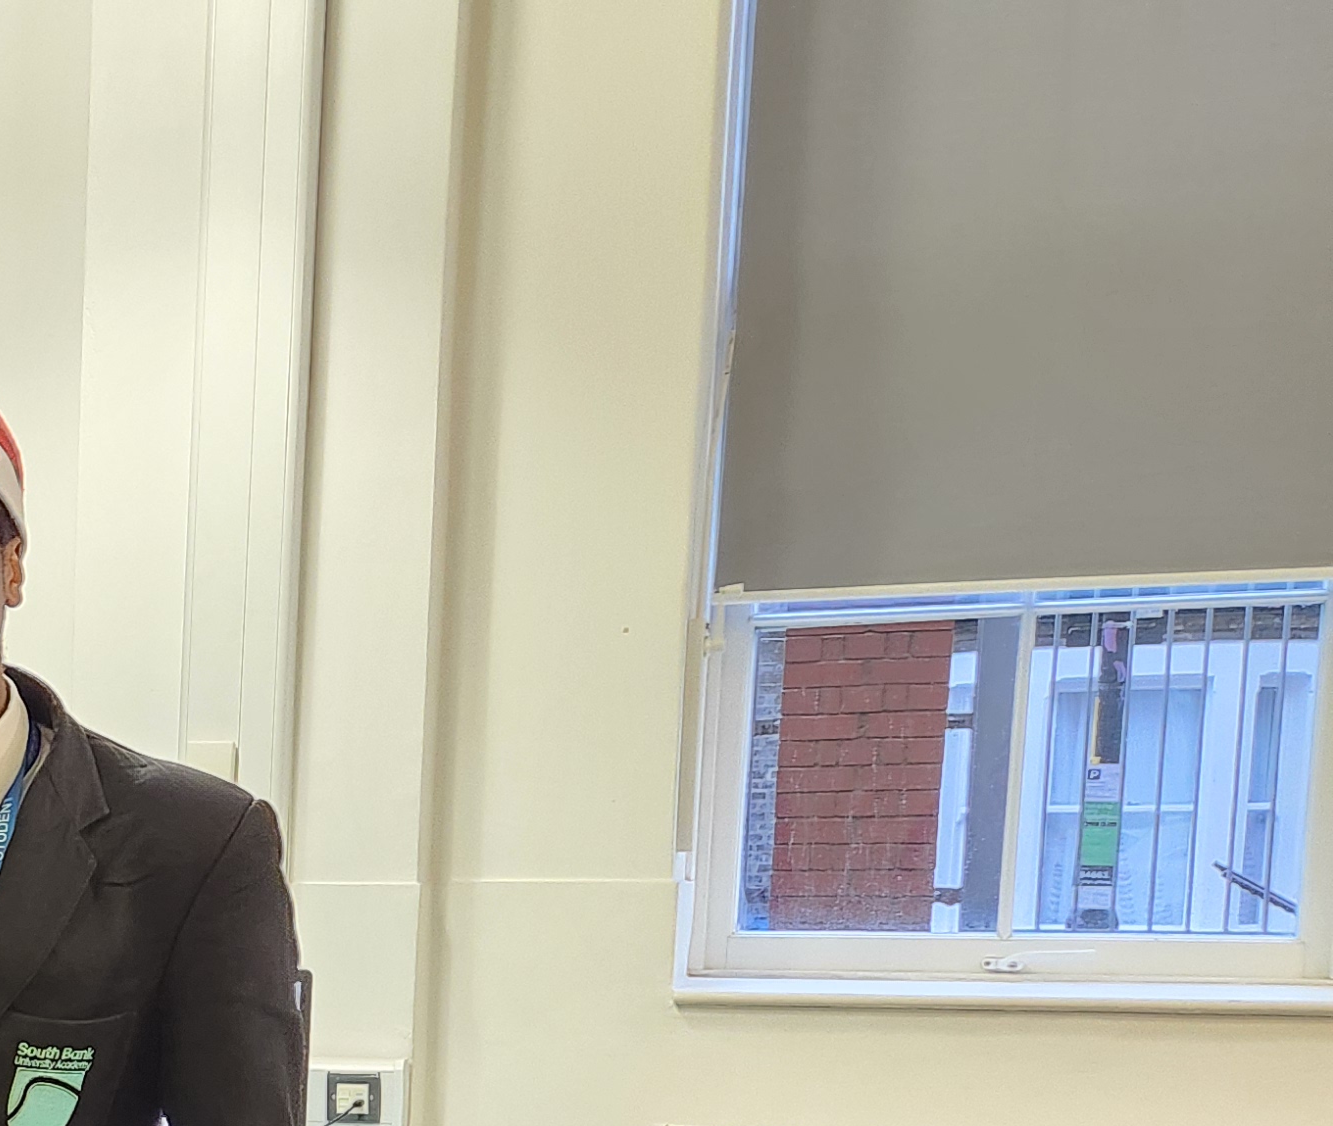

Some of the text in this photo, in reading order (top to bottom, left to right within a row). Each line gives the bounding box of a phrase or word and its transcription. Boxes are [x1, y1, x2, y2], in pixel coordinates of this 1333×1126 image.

[17, 1042, 95, 1060] South Bank
[14, 1056, 92, 1072] University Academy
